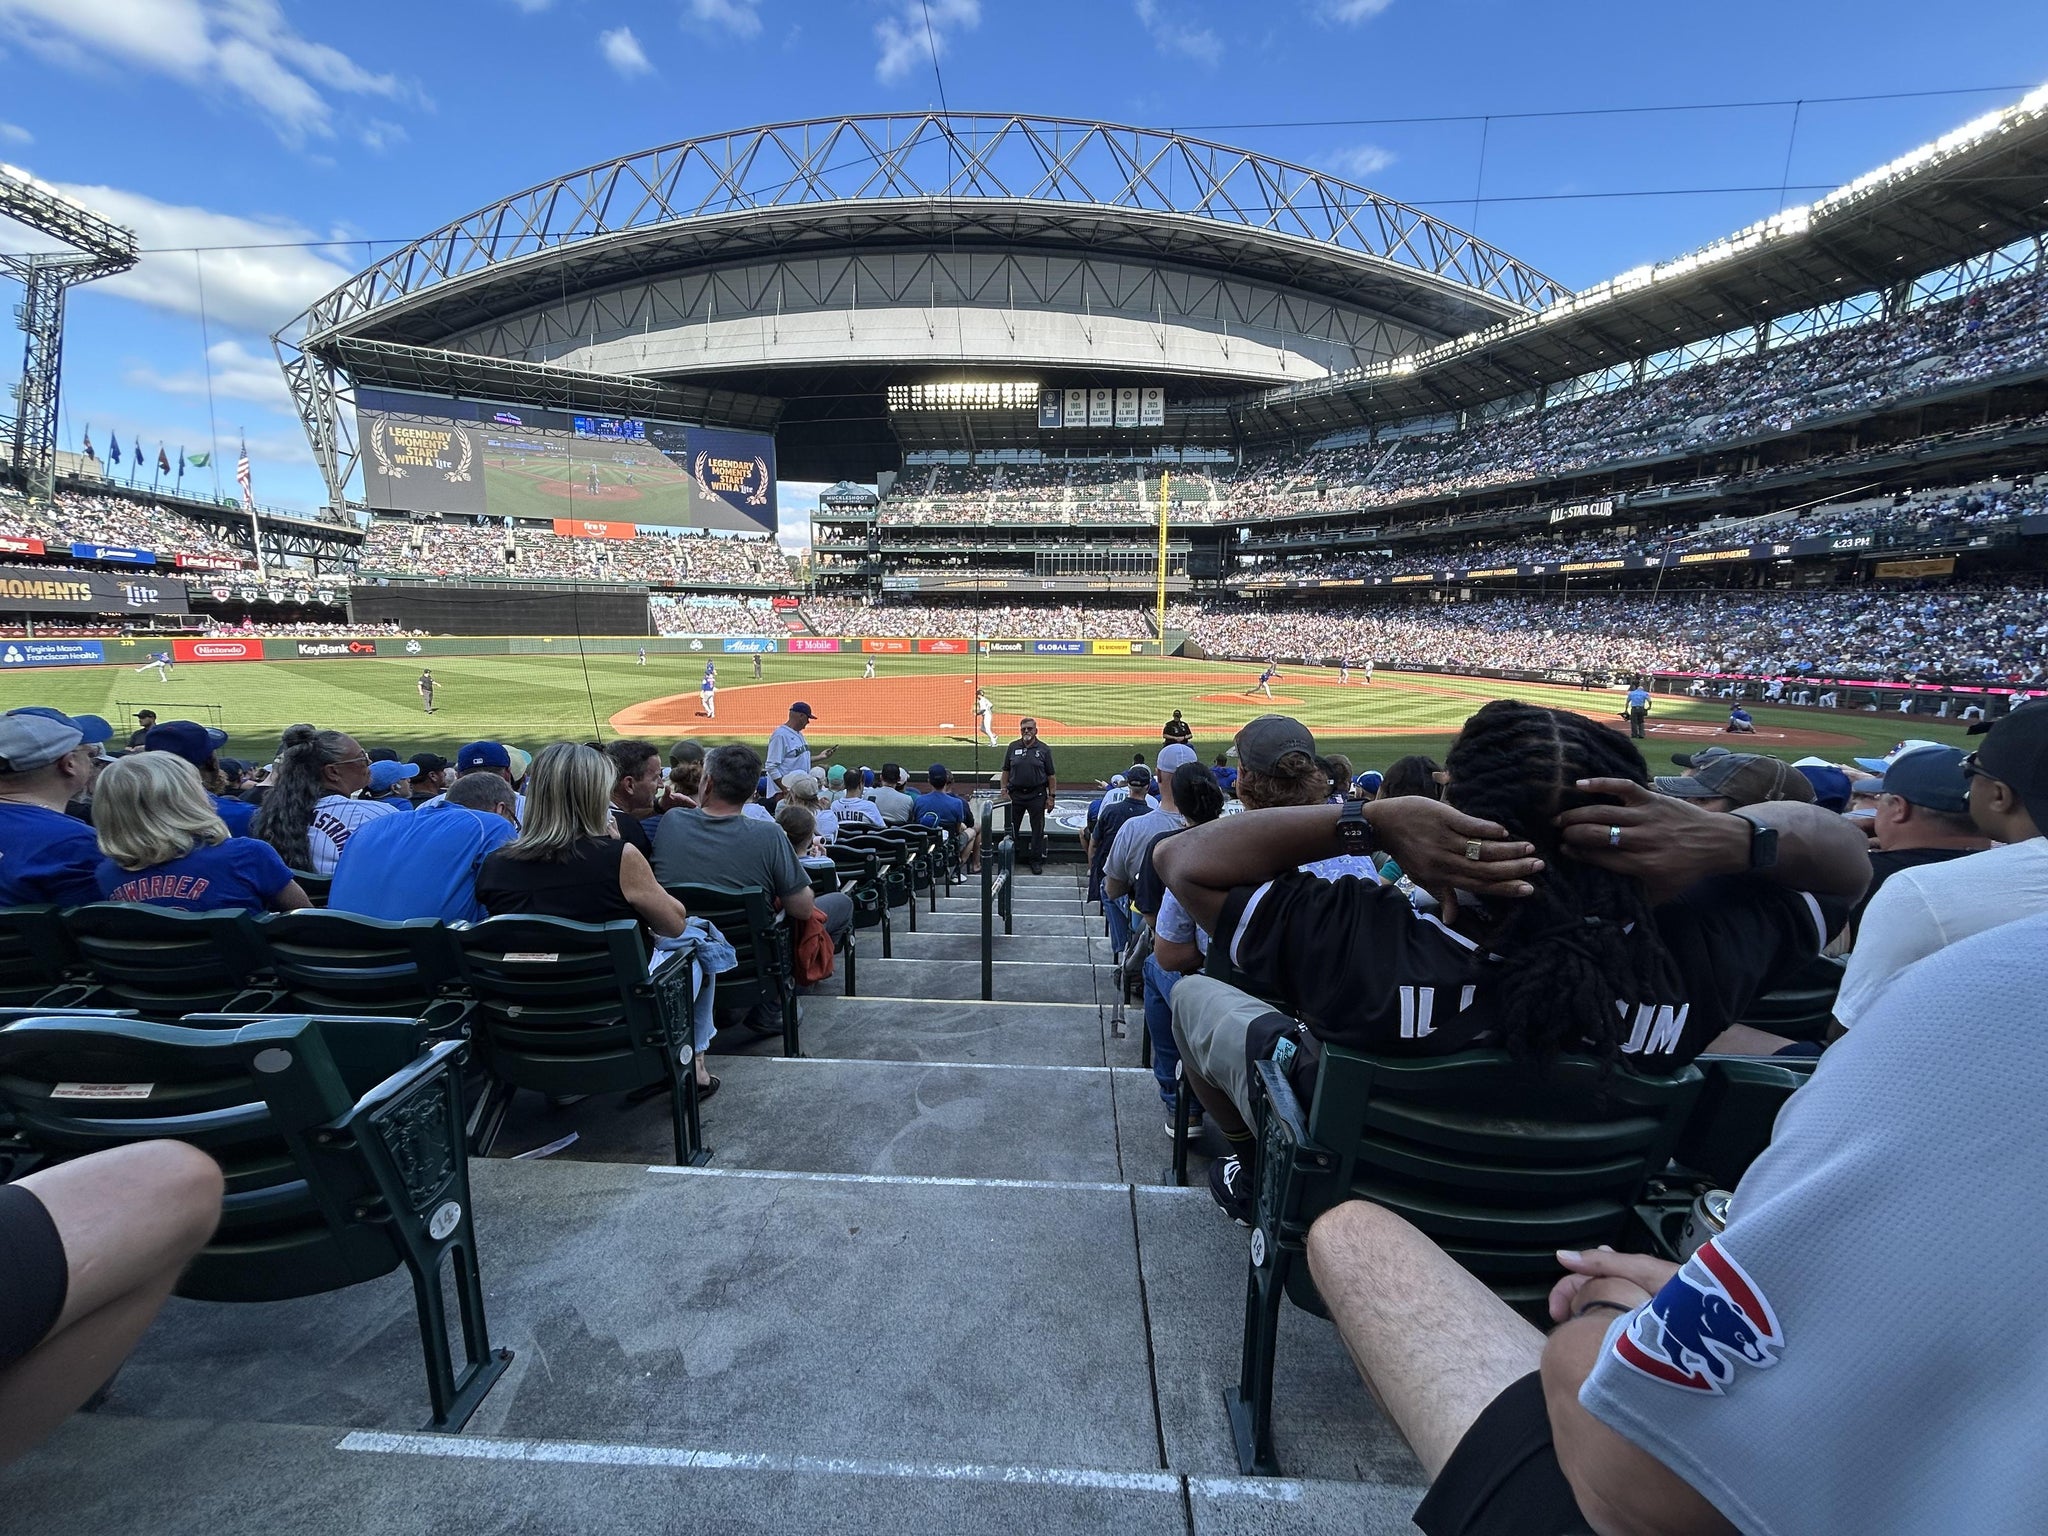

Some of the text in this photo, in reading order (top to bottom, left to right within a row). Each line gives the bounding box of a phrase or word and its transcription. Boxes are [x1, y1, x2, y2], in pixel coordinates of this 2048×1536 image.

[389, 426, 452, 442] LEGENDARY
[394, 436, 449, 451] MOMENTS
[406, 447, 440, 458] START
[394, 454, 452, 469] WITH A Lite
[708, 458, 754, 471] LEGENDARY
[711, 467, 752, 478] MOMENTS
[719, 476, 744, 485] START
[711, 481, 733, 492] WITH
[733, 484, 740, 492] A
[1550, 501, 1613, 524] ALL-STAR CLUB
[583, 522, 607, 532] fire tv
[1832, 536, 1870, 549] 4:23 PM
[1680, 549, 1750, 563] LEGENDARY MOMENTS
[1560, 560, 1625, 572] LEGENDARY MOMENTS
[1467, 568, 1518, 578] LEGENDARY MOMENTS
[126, 585, 159, 607] Lite
[24, 645, 56, 654] Virginia
[199, 645, 242, 654] Nintendo
[726, 641, 760, 651] Alaska
[805, 640, 832, 648] Mobile
[991, 643, 1022, 651] Microsoft
[1038, 643, 1067, 651] GLOBAL
[1131, 643, 1143, 651] CAT
[299, 644, 349, 656] KeyBank
[26, 652, 98, 661] Franciscan Health
[834, 811, 864, 822] ALEIGH
[436, 1208, 454, 1232] 14
[1253, 1234, 1262, 1258] 14
